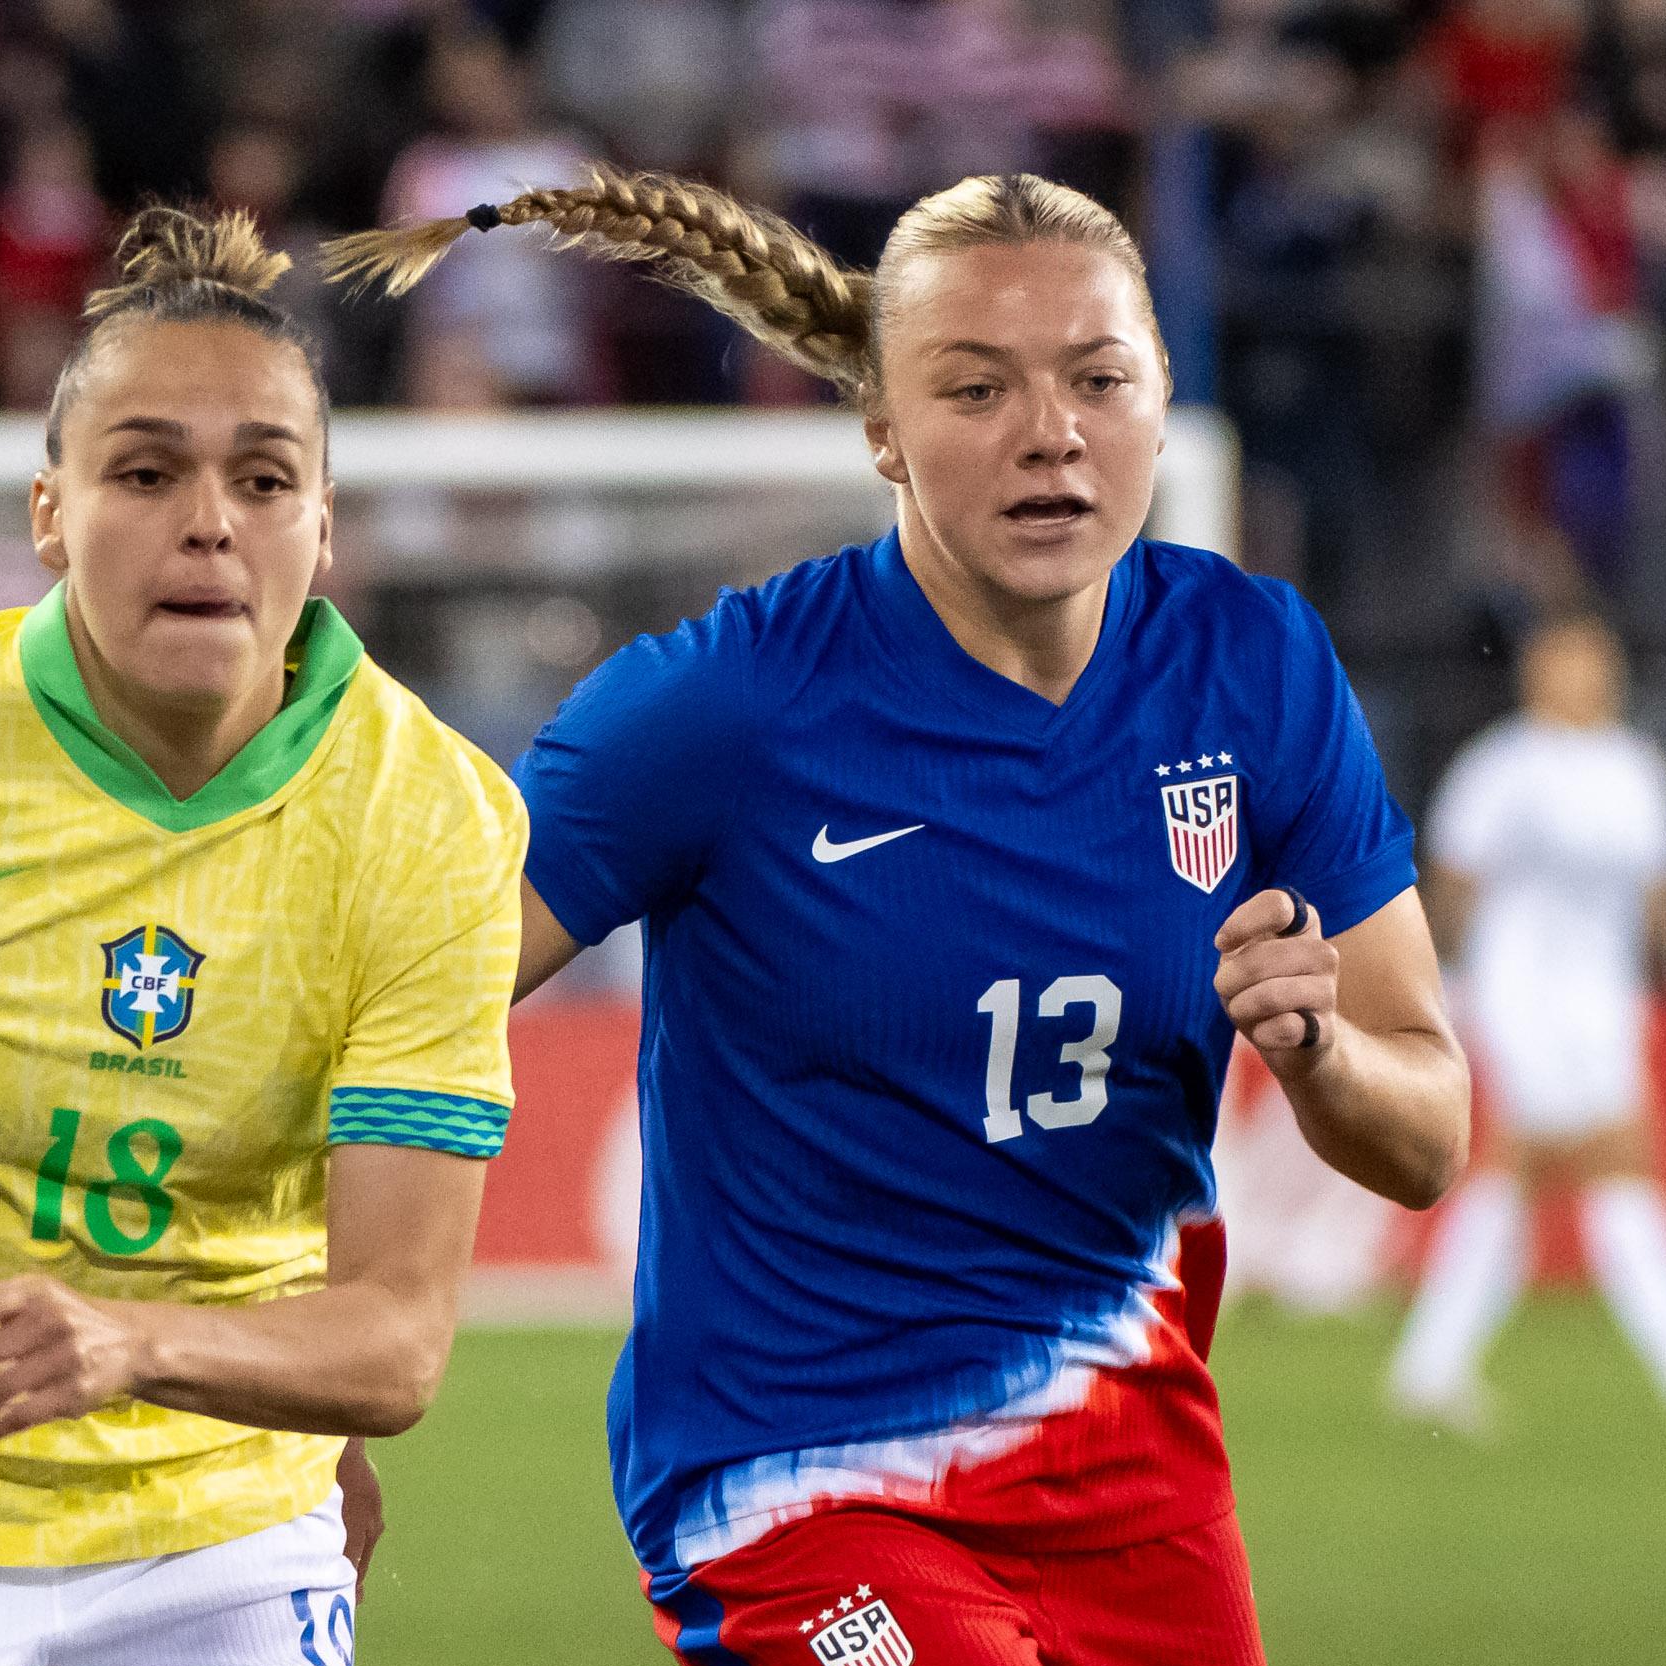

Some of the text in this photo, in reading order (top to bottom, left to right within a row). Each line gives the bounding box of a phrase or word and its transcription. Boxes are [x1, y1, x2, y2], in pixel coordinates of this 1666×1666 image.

[1167, 781, 1232, 828] USA
[131, 974, 167, 991] CBF
[89, 1051, 188, 1080] BRASIL
[977, 974, 1122, 1143] 13
[33, 1107, 184, 1256] 18
[816, 1605, 887, 1661] USA
